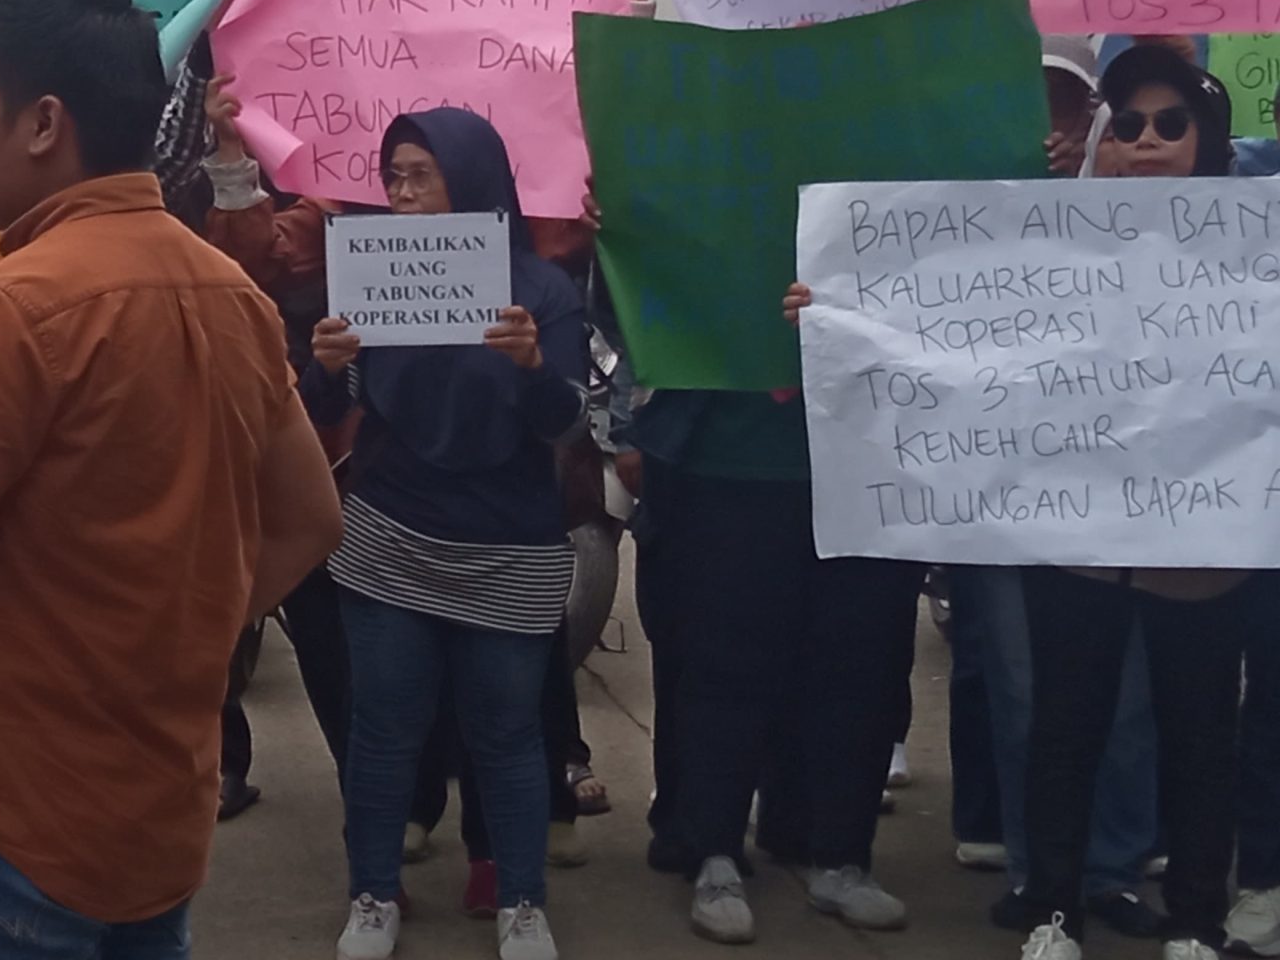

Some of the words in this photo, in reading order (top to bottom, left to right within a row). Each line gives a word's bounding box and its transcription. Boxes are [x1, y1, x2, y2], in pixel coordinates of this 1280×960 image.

[276, 31, 419, 72] SEMUA
[348, 236, 487, 253] KEMBALIKAN
[847, 199, 995, 258] BAPAK
[1019, 199, 1139, 242] AING
[1170, 195, 1280, 244] BAN
[363, 284, 476, 301] TABUNGAN
[389, 261, 447, 278] UANG
[856, 261, 1126, 310] KALUARKEUN
[1158, 252, 1280, 290] UANG
[339, 309, 440, 326] KOPERASI
[446, 308, 501, 325] KAMI
[857, 367, 940, 411] TOS
[974, 366, 1009, 413] 3
[1025, 357, 1173, 398] TAHUN
[1204, 352, 1278, 397] ACA
[892, 424, 1019, 470] KENEH
[1030, 413, 1129, 459] CAIR
[866, 481, 1091, 528] TULUNGAN
[1122, 475, 1241, 527] BAPAK
